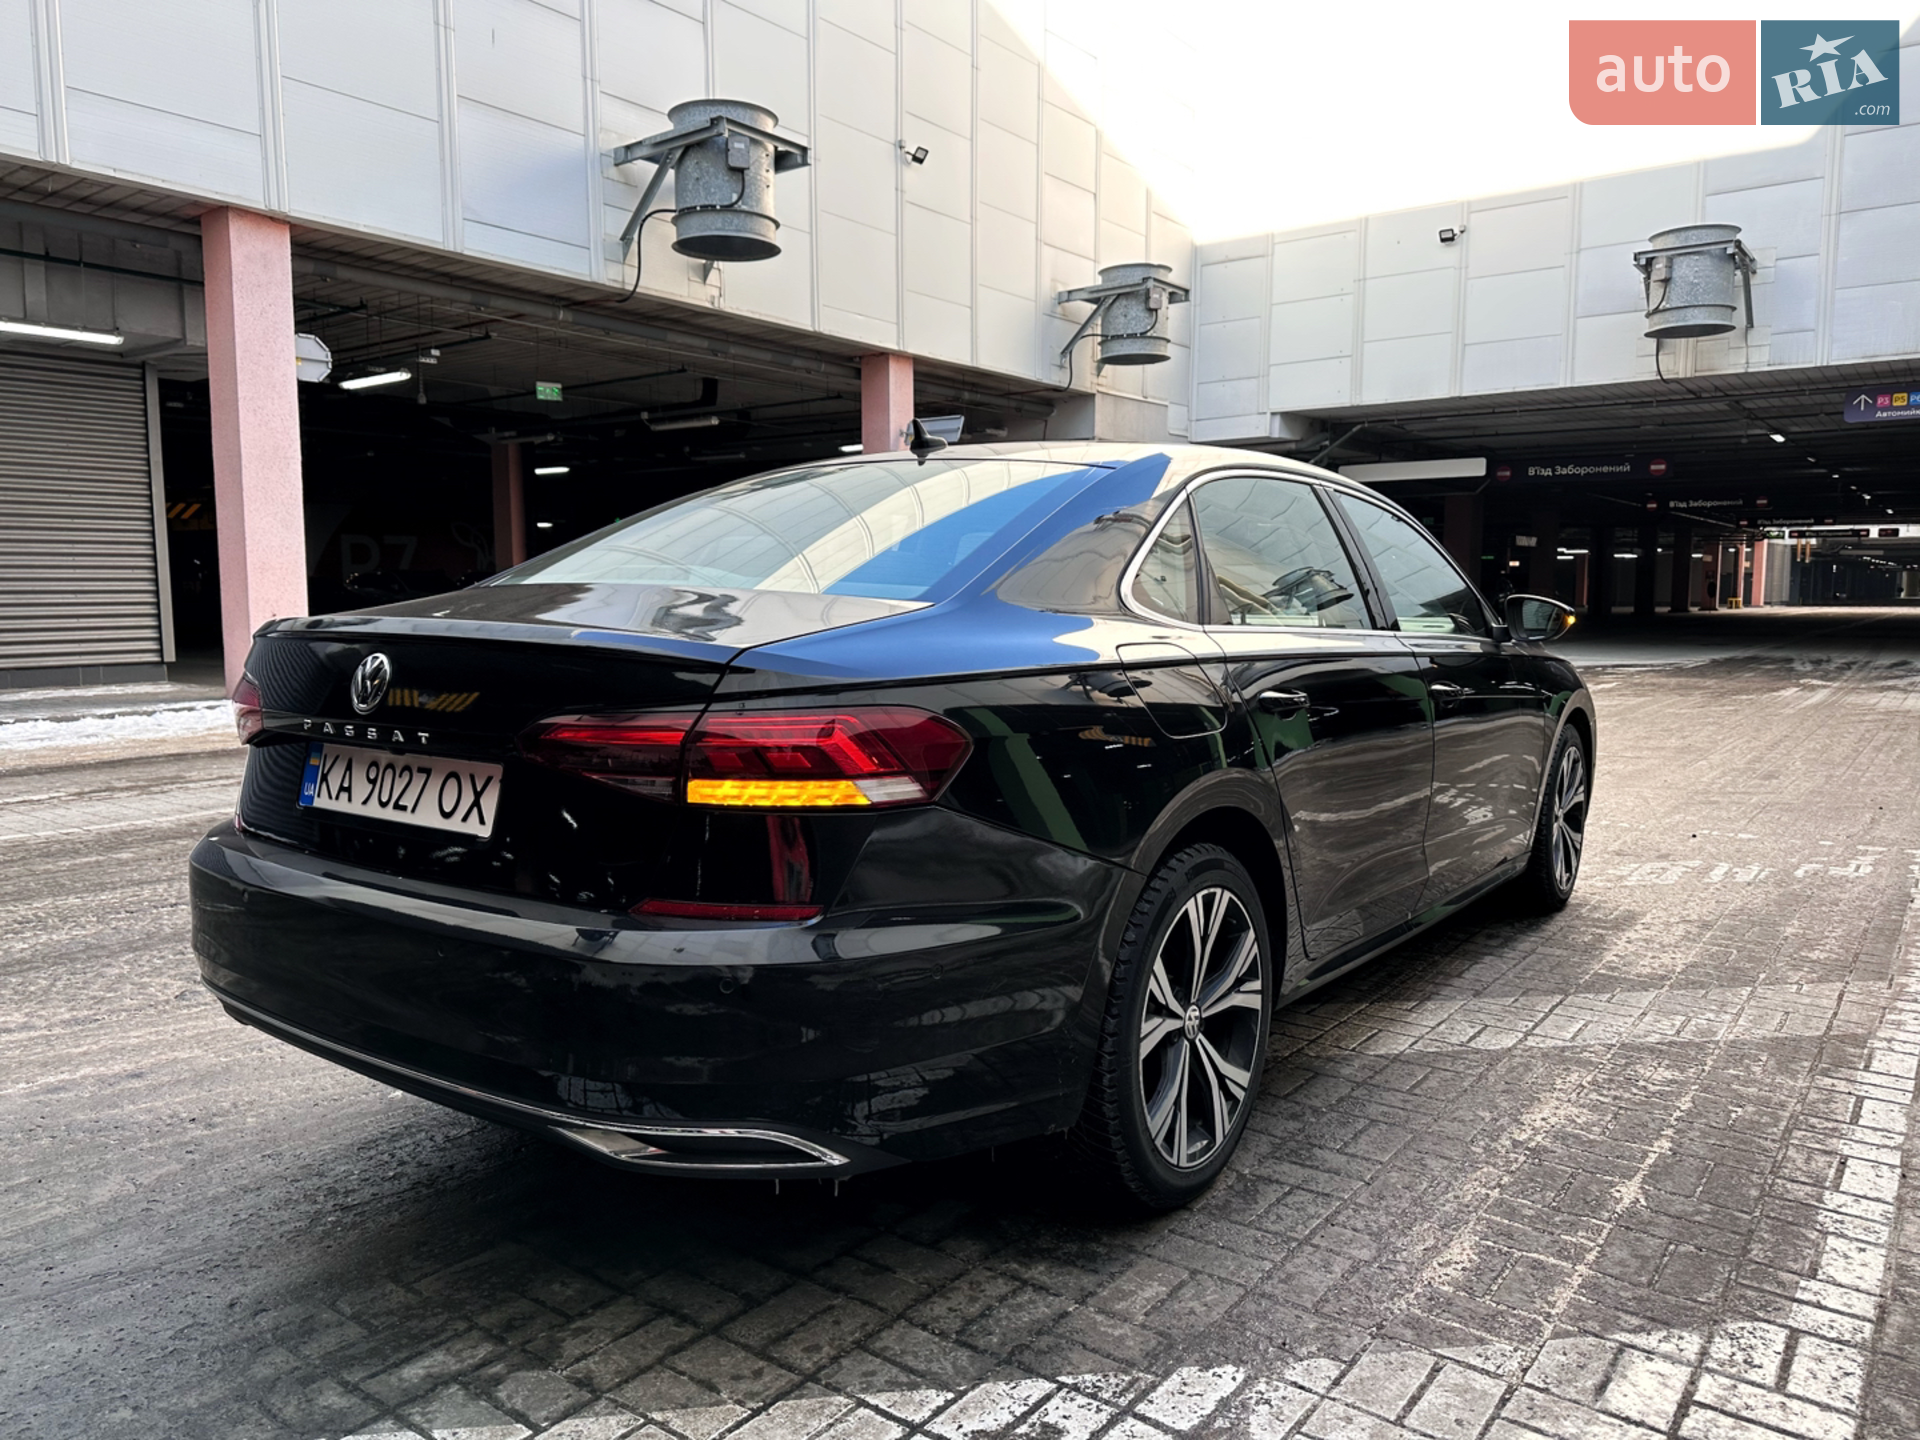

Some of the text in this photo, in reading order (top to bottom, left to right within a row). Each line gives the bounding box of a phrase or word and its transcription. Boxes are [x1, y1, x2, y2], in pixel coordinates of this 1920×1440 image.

[1894, 395, 1906, 404] P5
[1554, 462, 1631, 475] Заборонений
[303, 719, 430, 744] PASSAT
[304, 782, 315, 797] UA
[317, 753, 494, 826] KA 9027 OX
